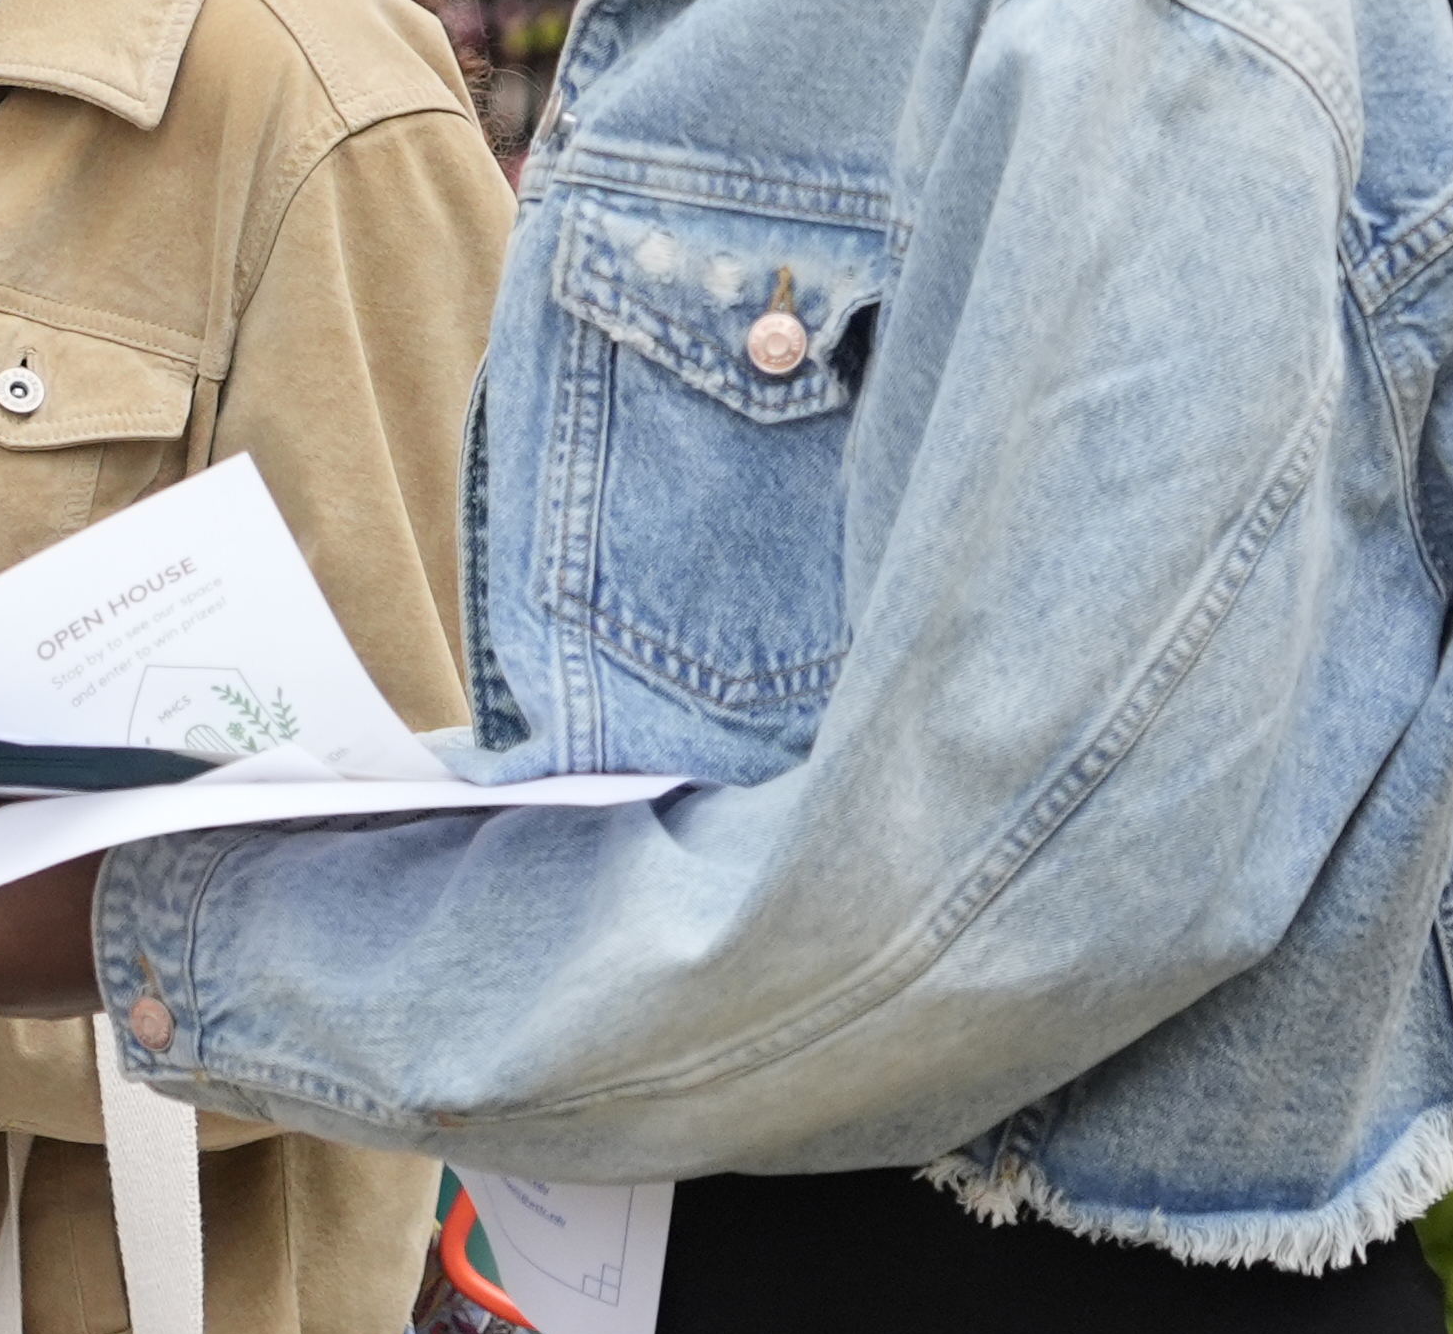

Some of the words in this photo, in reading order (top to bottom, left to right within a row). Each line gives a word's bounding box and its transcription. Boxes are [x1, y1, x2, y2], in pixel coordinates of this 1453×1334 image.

[37, 609, 104, 661] OPEN
[107, 557, 197, 616] HOUSE
[52, 663, 84, 690] Stop
[85, 648, 104, 666] by
[107, 636, 122, 652] to
[125, 621, 150, 642] see
[153, 604, 175, 622] our
[179, 577, 222, 607] space
[71, 683, 96, 709] and
[99, 657, 132, 687] enter
[135, 645, 151, 661] to
[153, 627, 179, 648] win
[181, 595, 228, 634] prizes!
[158, 694, 192, 724] MHCS
